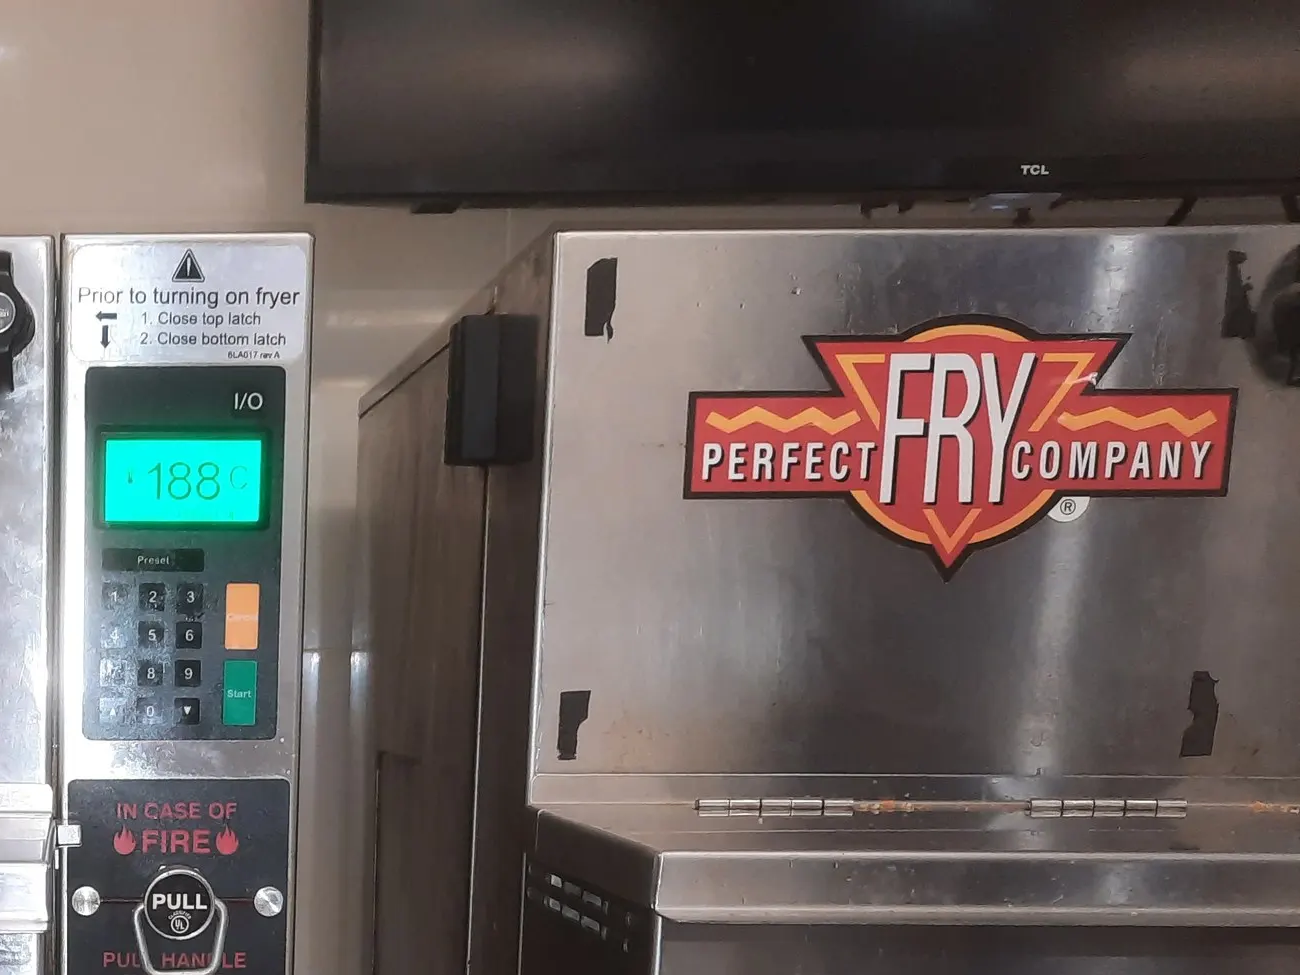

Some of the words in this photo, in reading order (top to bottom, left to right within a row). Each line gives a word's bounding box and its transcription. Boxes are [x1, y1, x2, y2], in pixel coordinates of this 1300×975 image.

[1020, 164, 1050, 175] TCL
[78, 287, 123, 304] Prior
[129, 288, 147, 304] to
[153, 287, 219, 308] turning
[225, 291, 249, 305] on
[256, 286, 300, 309] fryer
[141, 312, 153, 325] 1.
[158, 312, 198, 325] Close
[202, 313, 224, 328] top
[228, 312, 261, 325] latch
[140, 333, 153, 345] 2.
[157, 333, 197, 346] Close
[201, 333, 249, 346] bottom
[253, 333, 287, 346] latch
[272, 351, 281, 359] A
[234, 392, 264, 410] I/O
[701, 441, 877, 482] PERFECT
[879, 352, 1037, 504] FRY
[1011, 440, 1212, 480] COMPANY
[147, 461, 221, 500] 188
[137, 555, 170, 565] Preset
[110, 591, 118, 602] 1
[149, 591, 158, 603] 2
[186, 591, 195, 603] 3
[109, 627, 119, 641] 4
[148, 629, 157, 641] 5
[185, 629, 194, 641] 6
[146, 667, 156, 679] 8
[184, 667, 193, 679] 9
[227, 688, 252, 698] Start
[146, 705, 155, 717] 0
[117, 802, 137, 819] IN
[144, 802, 201, 819] CASE
[208, 802, 238, 819] OF
[142, 829, 212, 853] FIRE
[152, 893, 208, 910] PULL
[102, 952, 141, 968] PUL
[161, 952, 247, 969] HANLE
